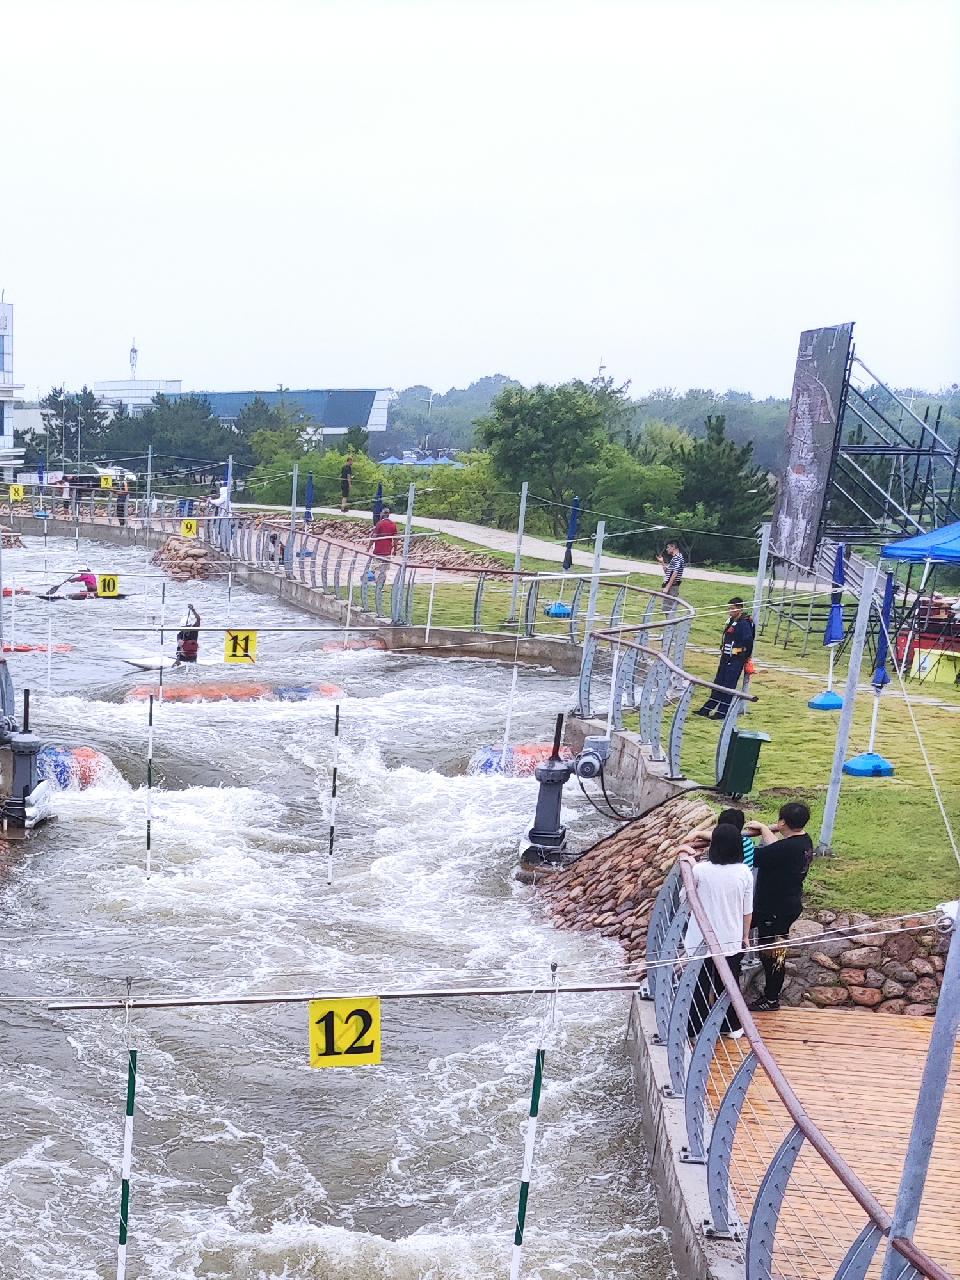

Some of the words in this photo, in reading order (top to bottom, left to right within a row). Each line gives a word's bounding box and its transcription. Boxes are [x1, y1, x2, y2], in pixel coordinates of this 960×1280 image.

[185, 521, 192, 534] 9
[100, 577, 116, 593] 10
[228, 634, 250, 658] 11
[315, 1008, 375, 1056] 12
